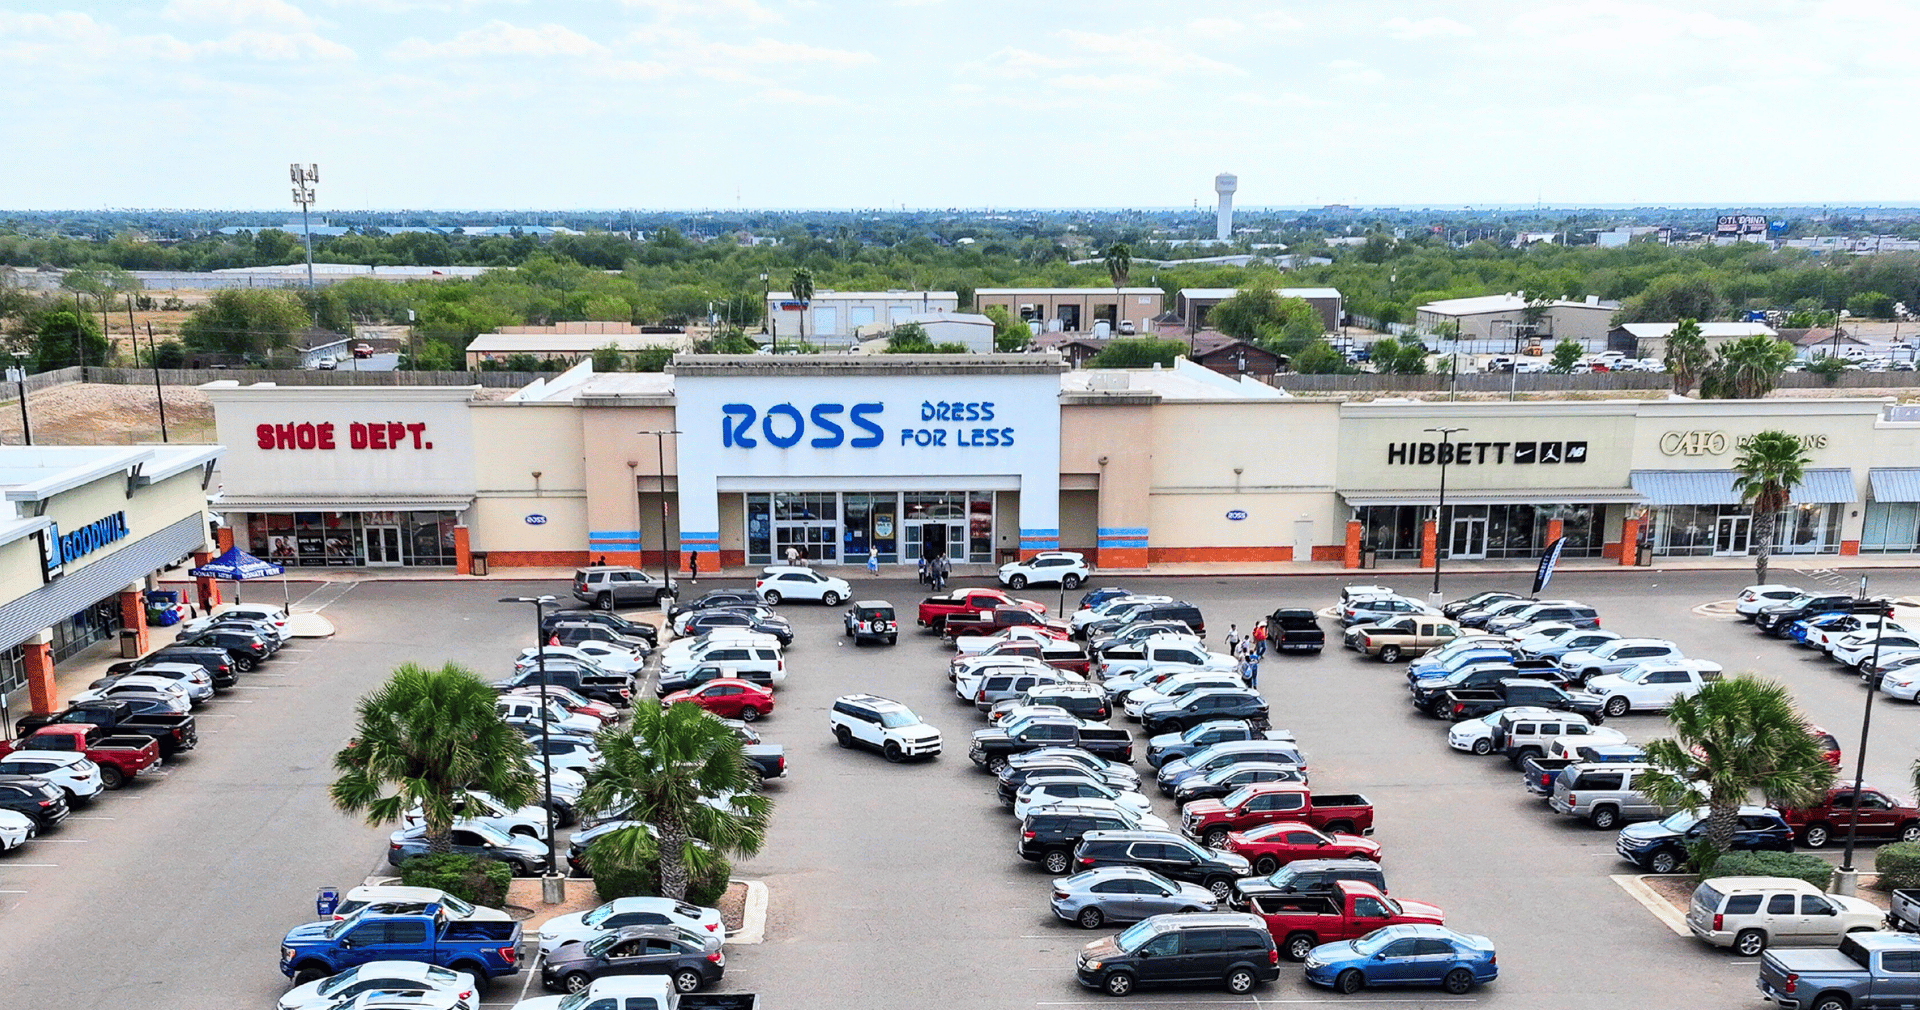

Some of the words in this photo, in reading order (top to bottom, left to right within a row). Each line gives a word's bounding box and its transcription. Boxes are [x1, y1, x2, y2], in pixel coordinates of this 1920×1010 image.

[921, 402, 995, 421] DRESS
[256, 424, 335, 450] SHOE
[350, 424, 433, 450] DEPT.
[722, 403, 884, 448] ROSS
[901, 429, 947, 447] FOR
[958, 428, 1015, 447] LESS
[1388, 442, 1511, 465] HIBBETT
[1660, 431, 1730, 456] CATO
[60, 510, 130, 564] GOODWILL
